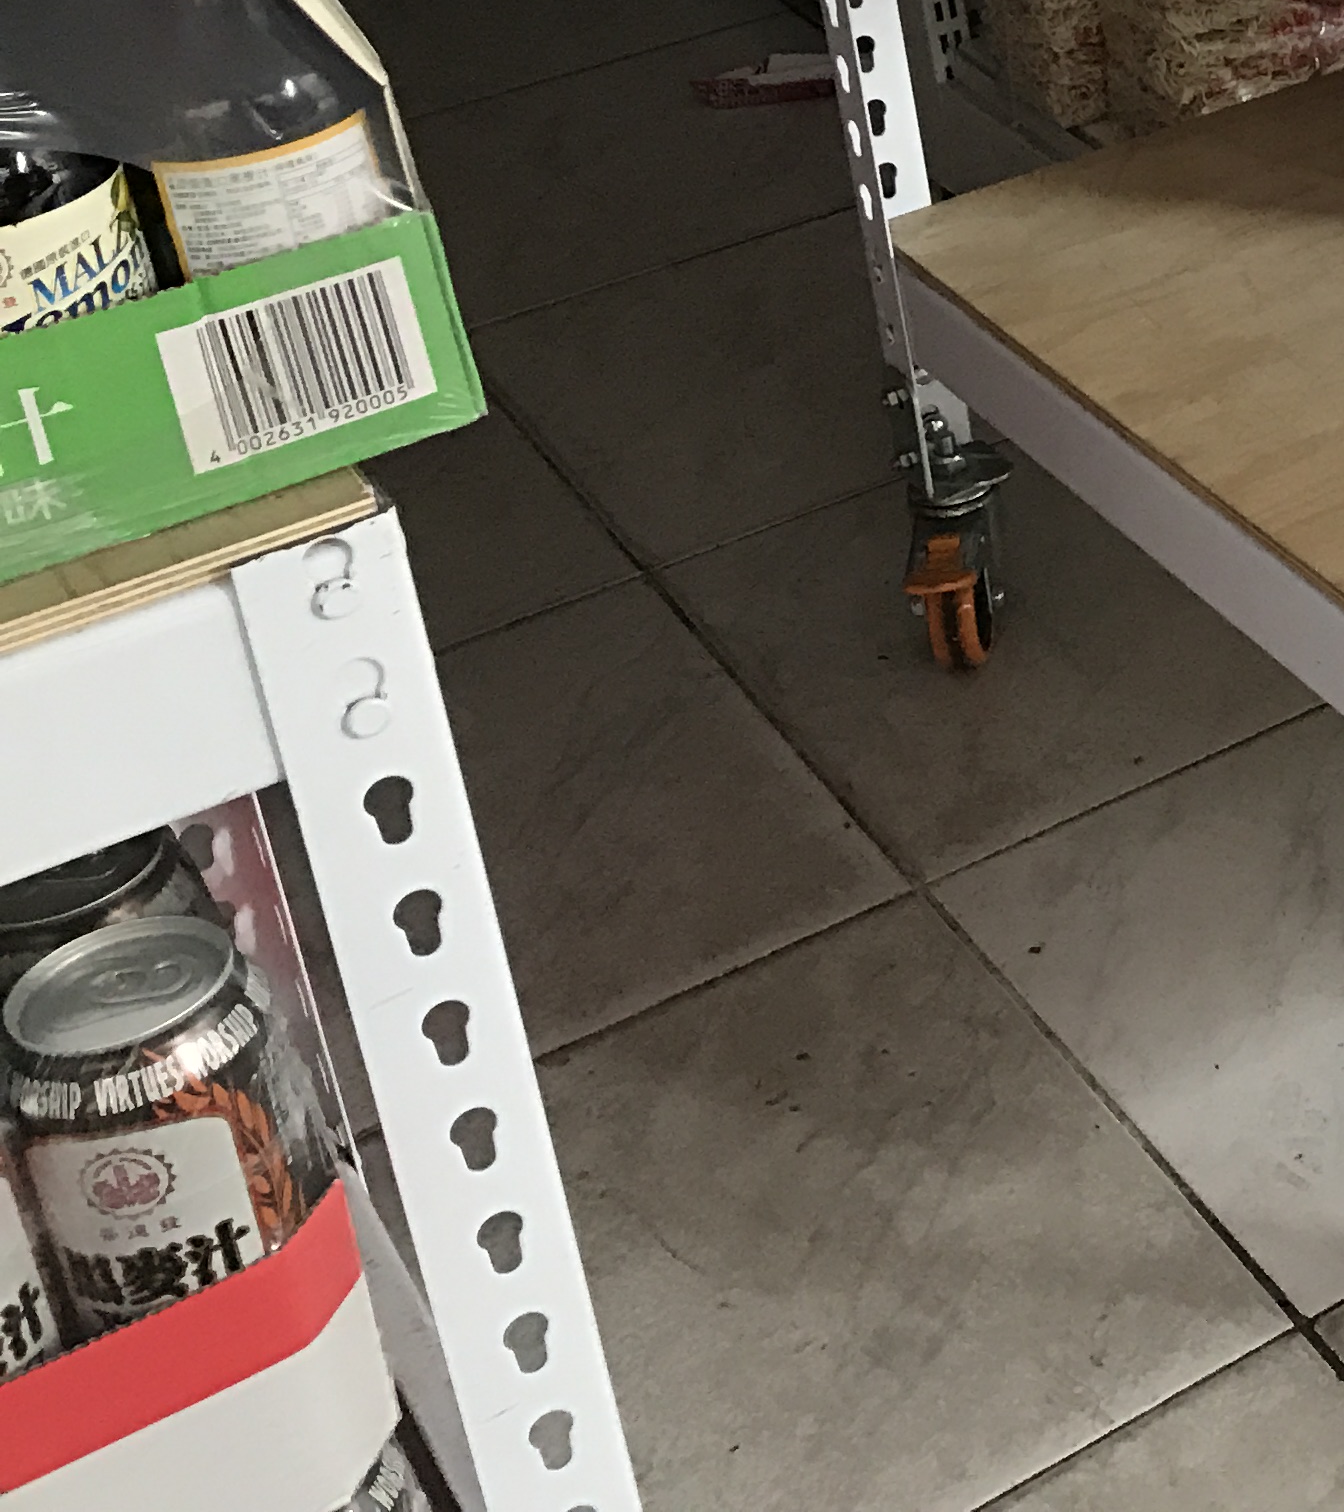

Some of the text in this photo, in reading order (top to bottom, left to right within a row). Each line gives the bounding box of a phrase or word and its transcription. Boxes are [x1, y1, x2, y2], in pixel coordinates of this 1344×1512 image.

[209, 384, 410, 466] 4 002631 920005
[93, 1052, 187, 1117] VIRTUES
